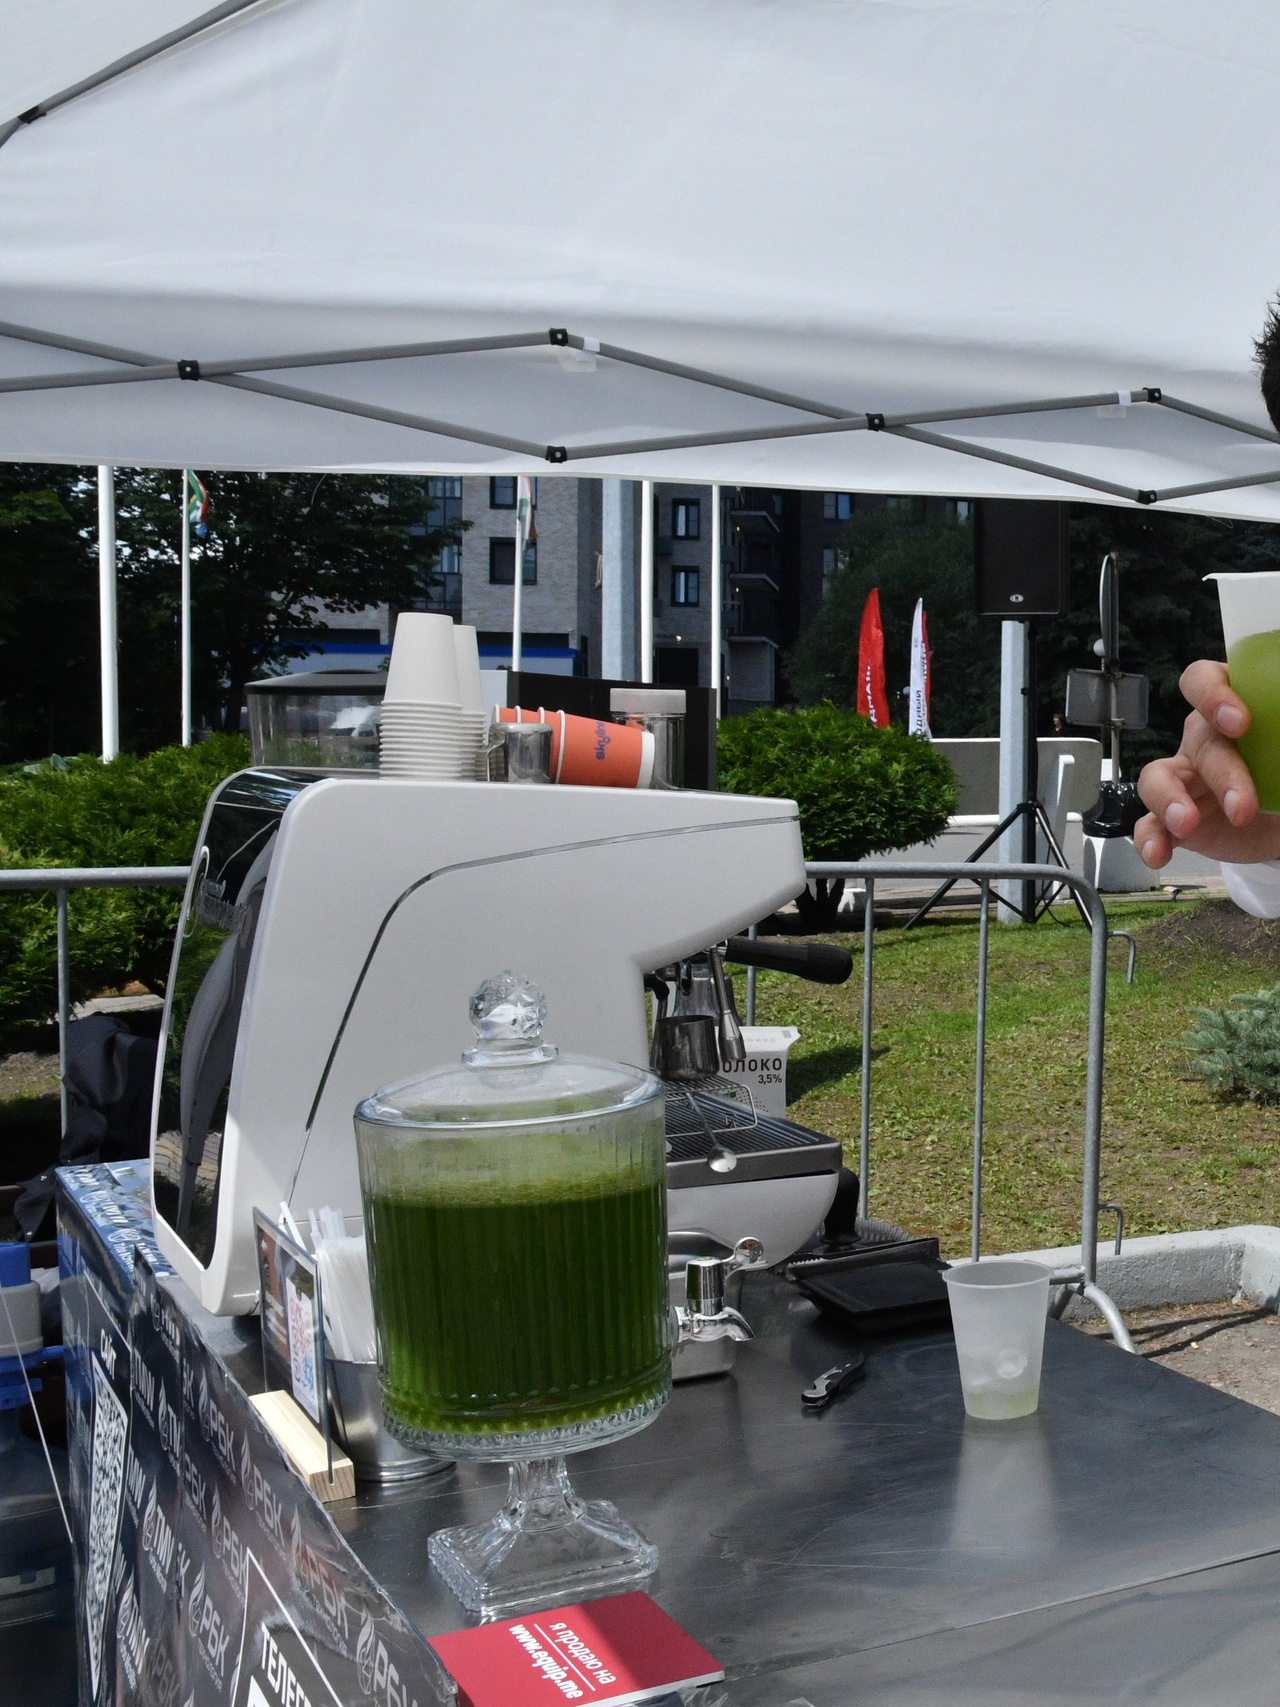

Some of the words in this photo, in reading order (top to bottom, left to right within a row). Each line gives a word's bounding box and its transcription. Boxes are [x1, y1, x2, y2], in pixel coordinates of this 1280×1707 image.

[722, 1058, 782, 1073] ОЛОКО
[757, 1074, 783, 1085] 3,5%
[210, 1398, 236, 1473] РБК
[253, 1463, 285, 1547] РБК
[200, 1594, 230, 1678] РБК
[261, 1621, 312, 1707] ТЕЛЕГ
[509, 1624, 584, 1699] www.equip.me
[554, 1629, 603, 1670] продаю
[593, 1669, 617, 1685] на
